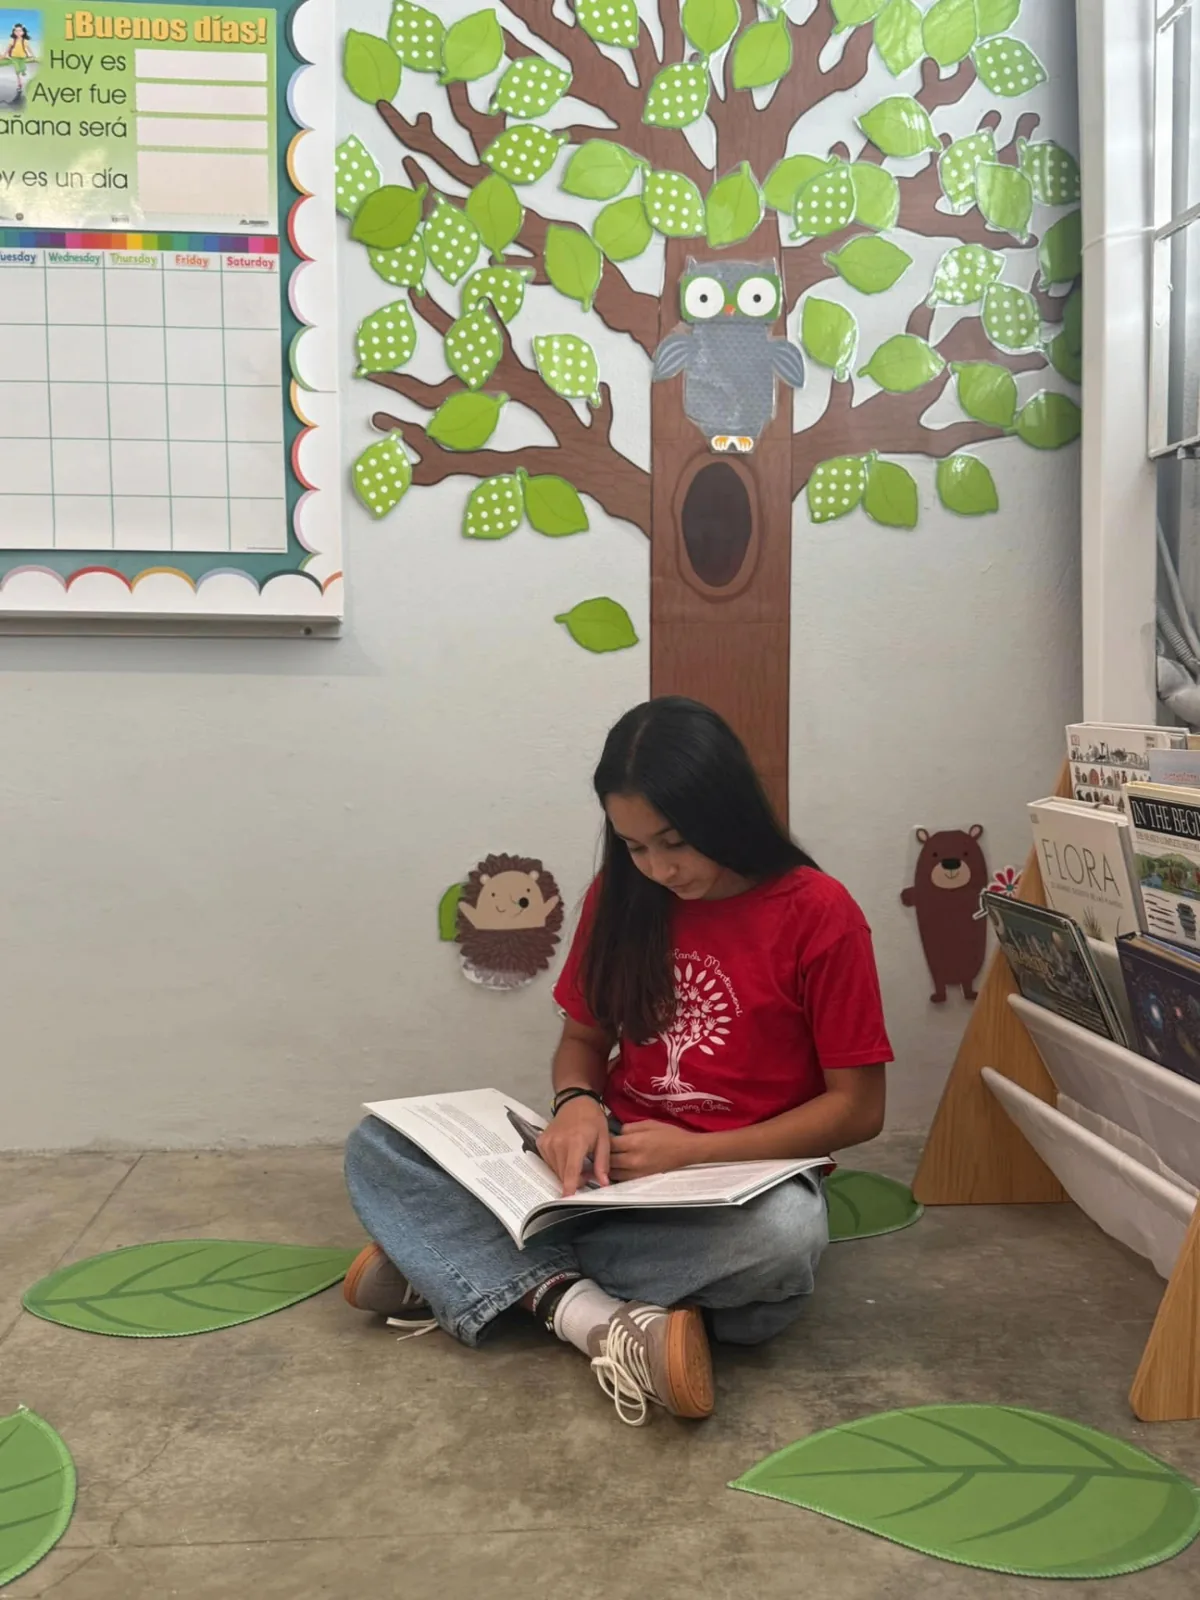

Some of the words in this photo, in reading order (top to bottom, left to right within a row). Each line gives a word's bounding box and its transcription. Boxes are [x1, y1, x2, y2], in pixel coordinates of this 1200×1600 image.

[64, 10, 188, 42] ¡Buenos
[193, 14, 268, 45] días!
[49, 49, 94, 74] Hoy
[100, 55, 127, 72] es
[31, 82, 83, 107] Ayer
[89, 83, 127, 105] fue
[79, 116, 127, 137] será
[0, 170, 16, 190] y
[22, 170, 48, 187] es
[55, 171, 84, 188] un
[91, 167, 128, 189] día
[48, 251, 101, 266] Wednesday
[110, 252, 158, 267] Thursday
[175, 254, 210, 268] Friday
[226, 256, 275, 270] Saturday
[1131, 800, 1147, 826] IN
[1145, 803, 1172, 831] THE
[1171, 807, 1200, 837] BEGI
[1041, 838, 1121, 897] FLORA
